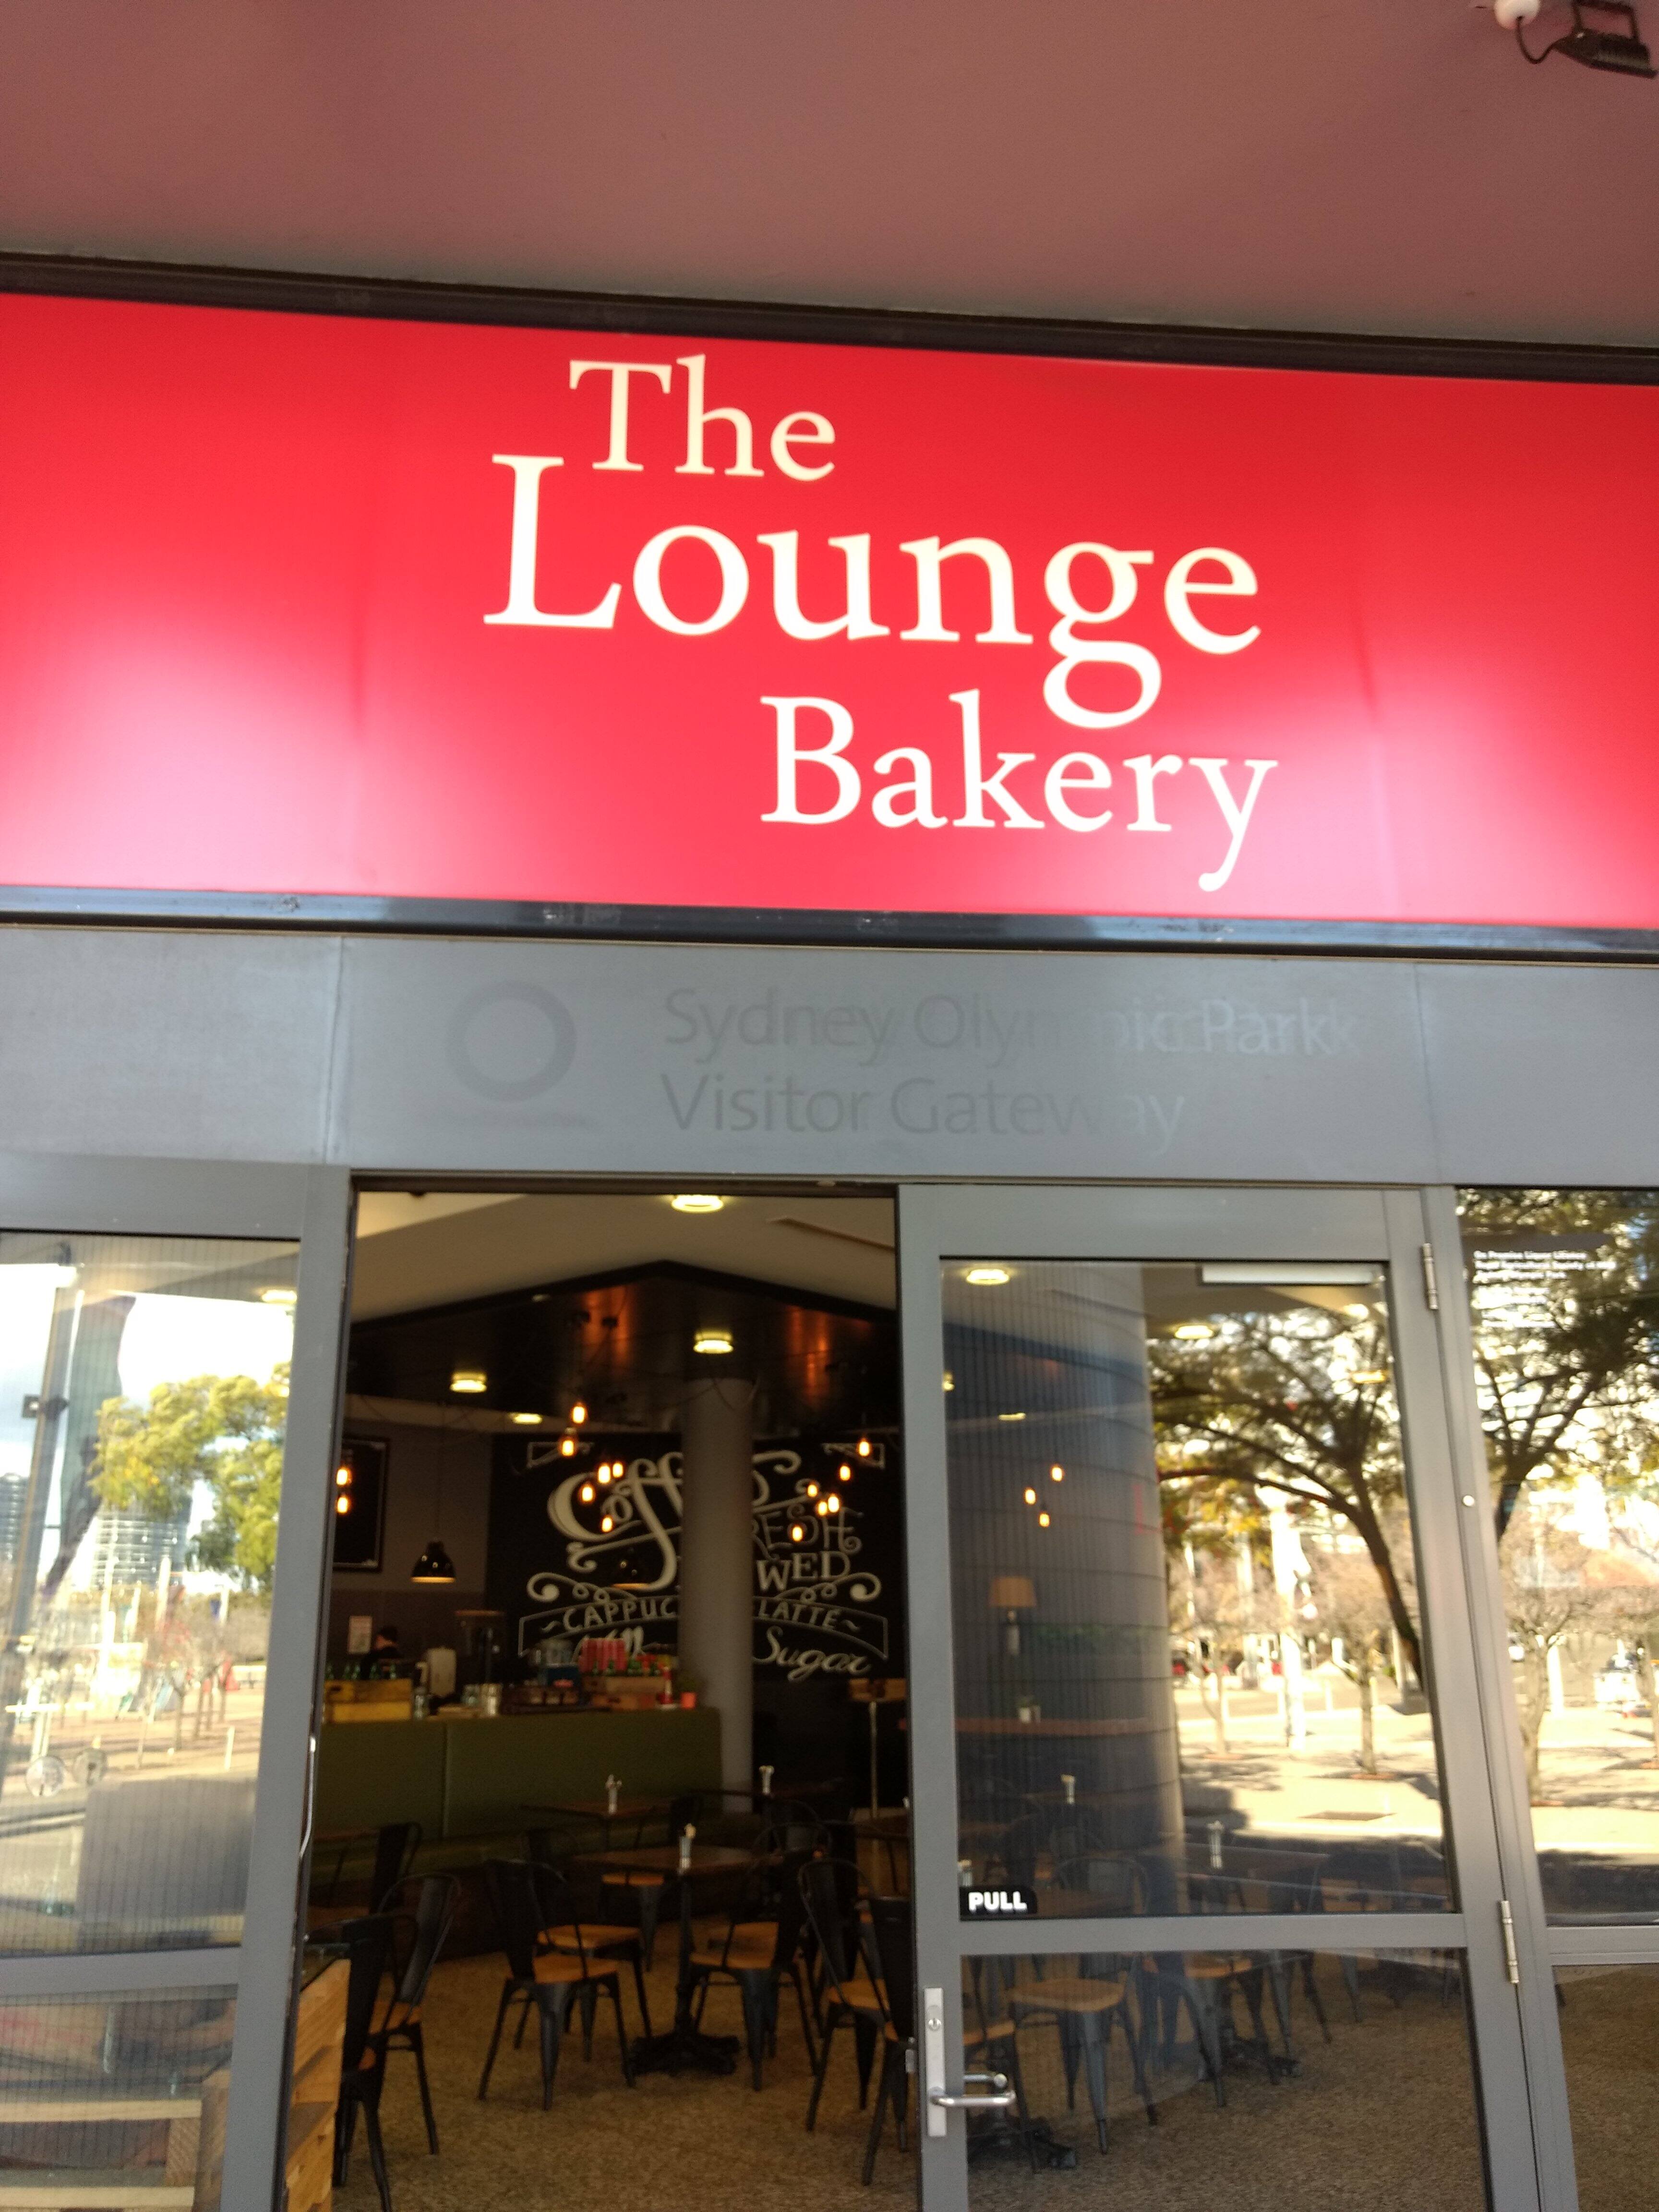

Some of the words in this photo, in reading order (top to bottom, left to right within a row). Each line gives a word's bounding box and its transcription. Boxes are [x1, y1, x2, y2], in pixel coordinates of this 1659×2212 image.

[570, 354, 835, 481] The
[483, 454, 1261, 729] Lounge
[761, 689, 1277, 892] Bakery
[662, 986, 896, 1067] Sydney
[660, 1073, 871, 1133] Visitor
[757, 1551, 851, 1592] WED
[562, 1596, 677, 1632] CAPPUC
[757, 1598, 842, 1632] LATTE
[752, 1625, 874, 1681] Sugar
[968, 1891, 1027, 1912] PULL
